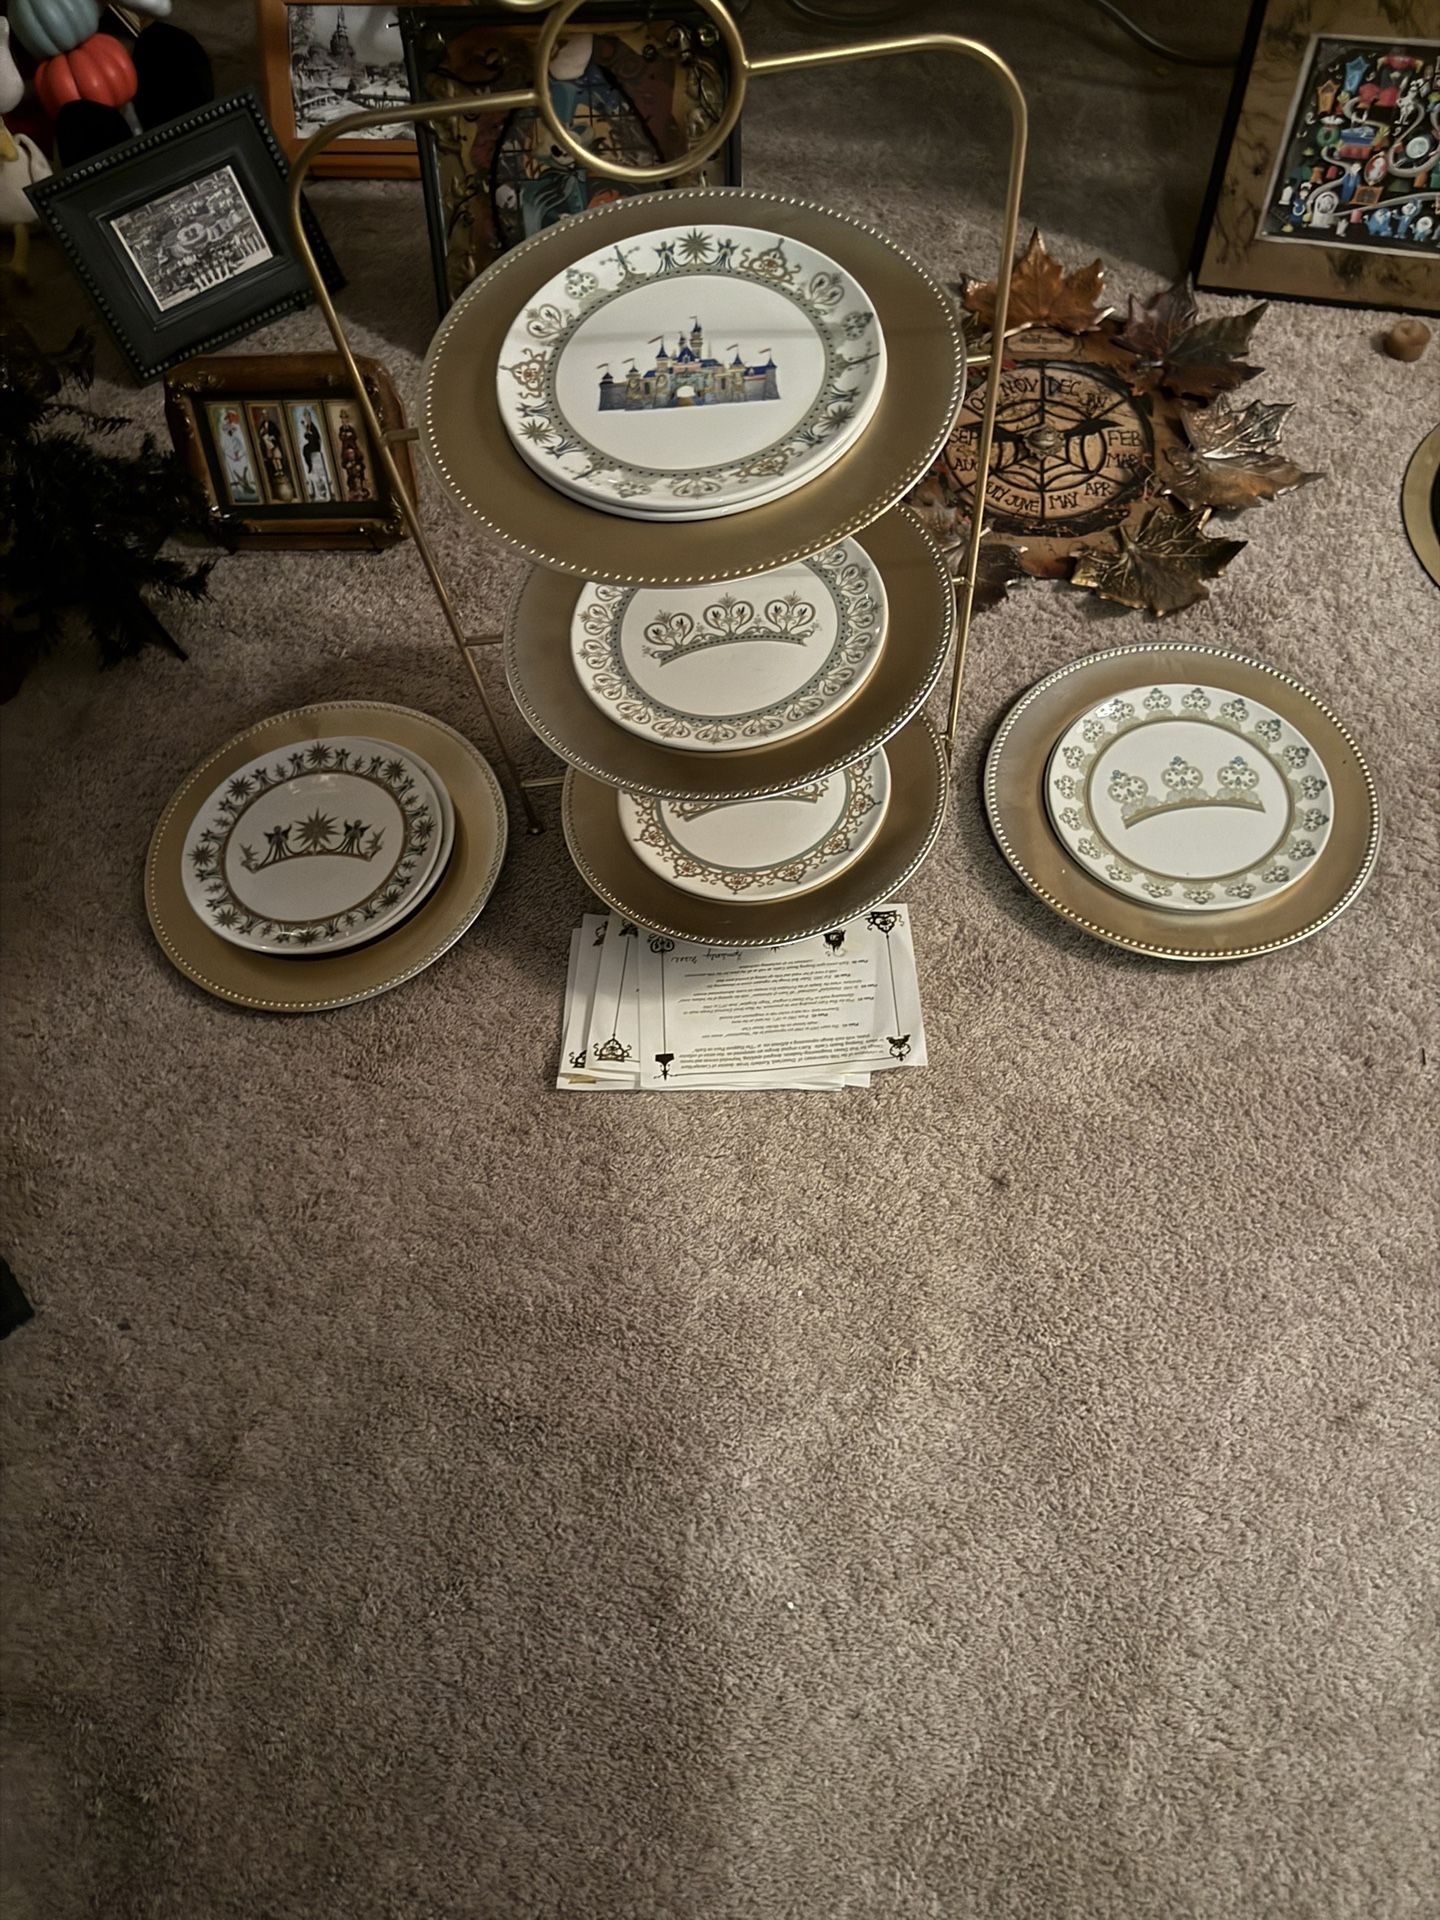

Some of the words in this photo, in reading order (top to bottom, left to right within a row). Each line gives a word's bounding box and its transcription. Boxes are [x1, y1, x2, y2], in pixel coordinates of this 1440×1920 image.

[1000, 377, 1039, 397] NOV
[1048, 377, 1081, 397] DEC
[949, 427, 979, 446] SEP
[1107, 430, 1140, 447] FEB
[1084, 482, 1113, 497] APR
[1004, 495, 1040, 514] JUNE
[1048, 492, 1078, 510] MAY
